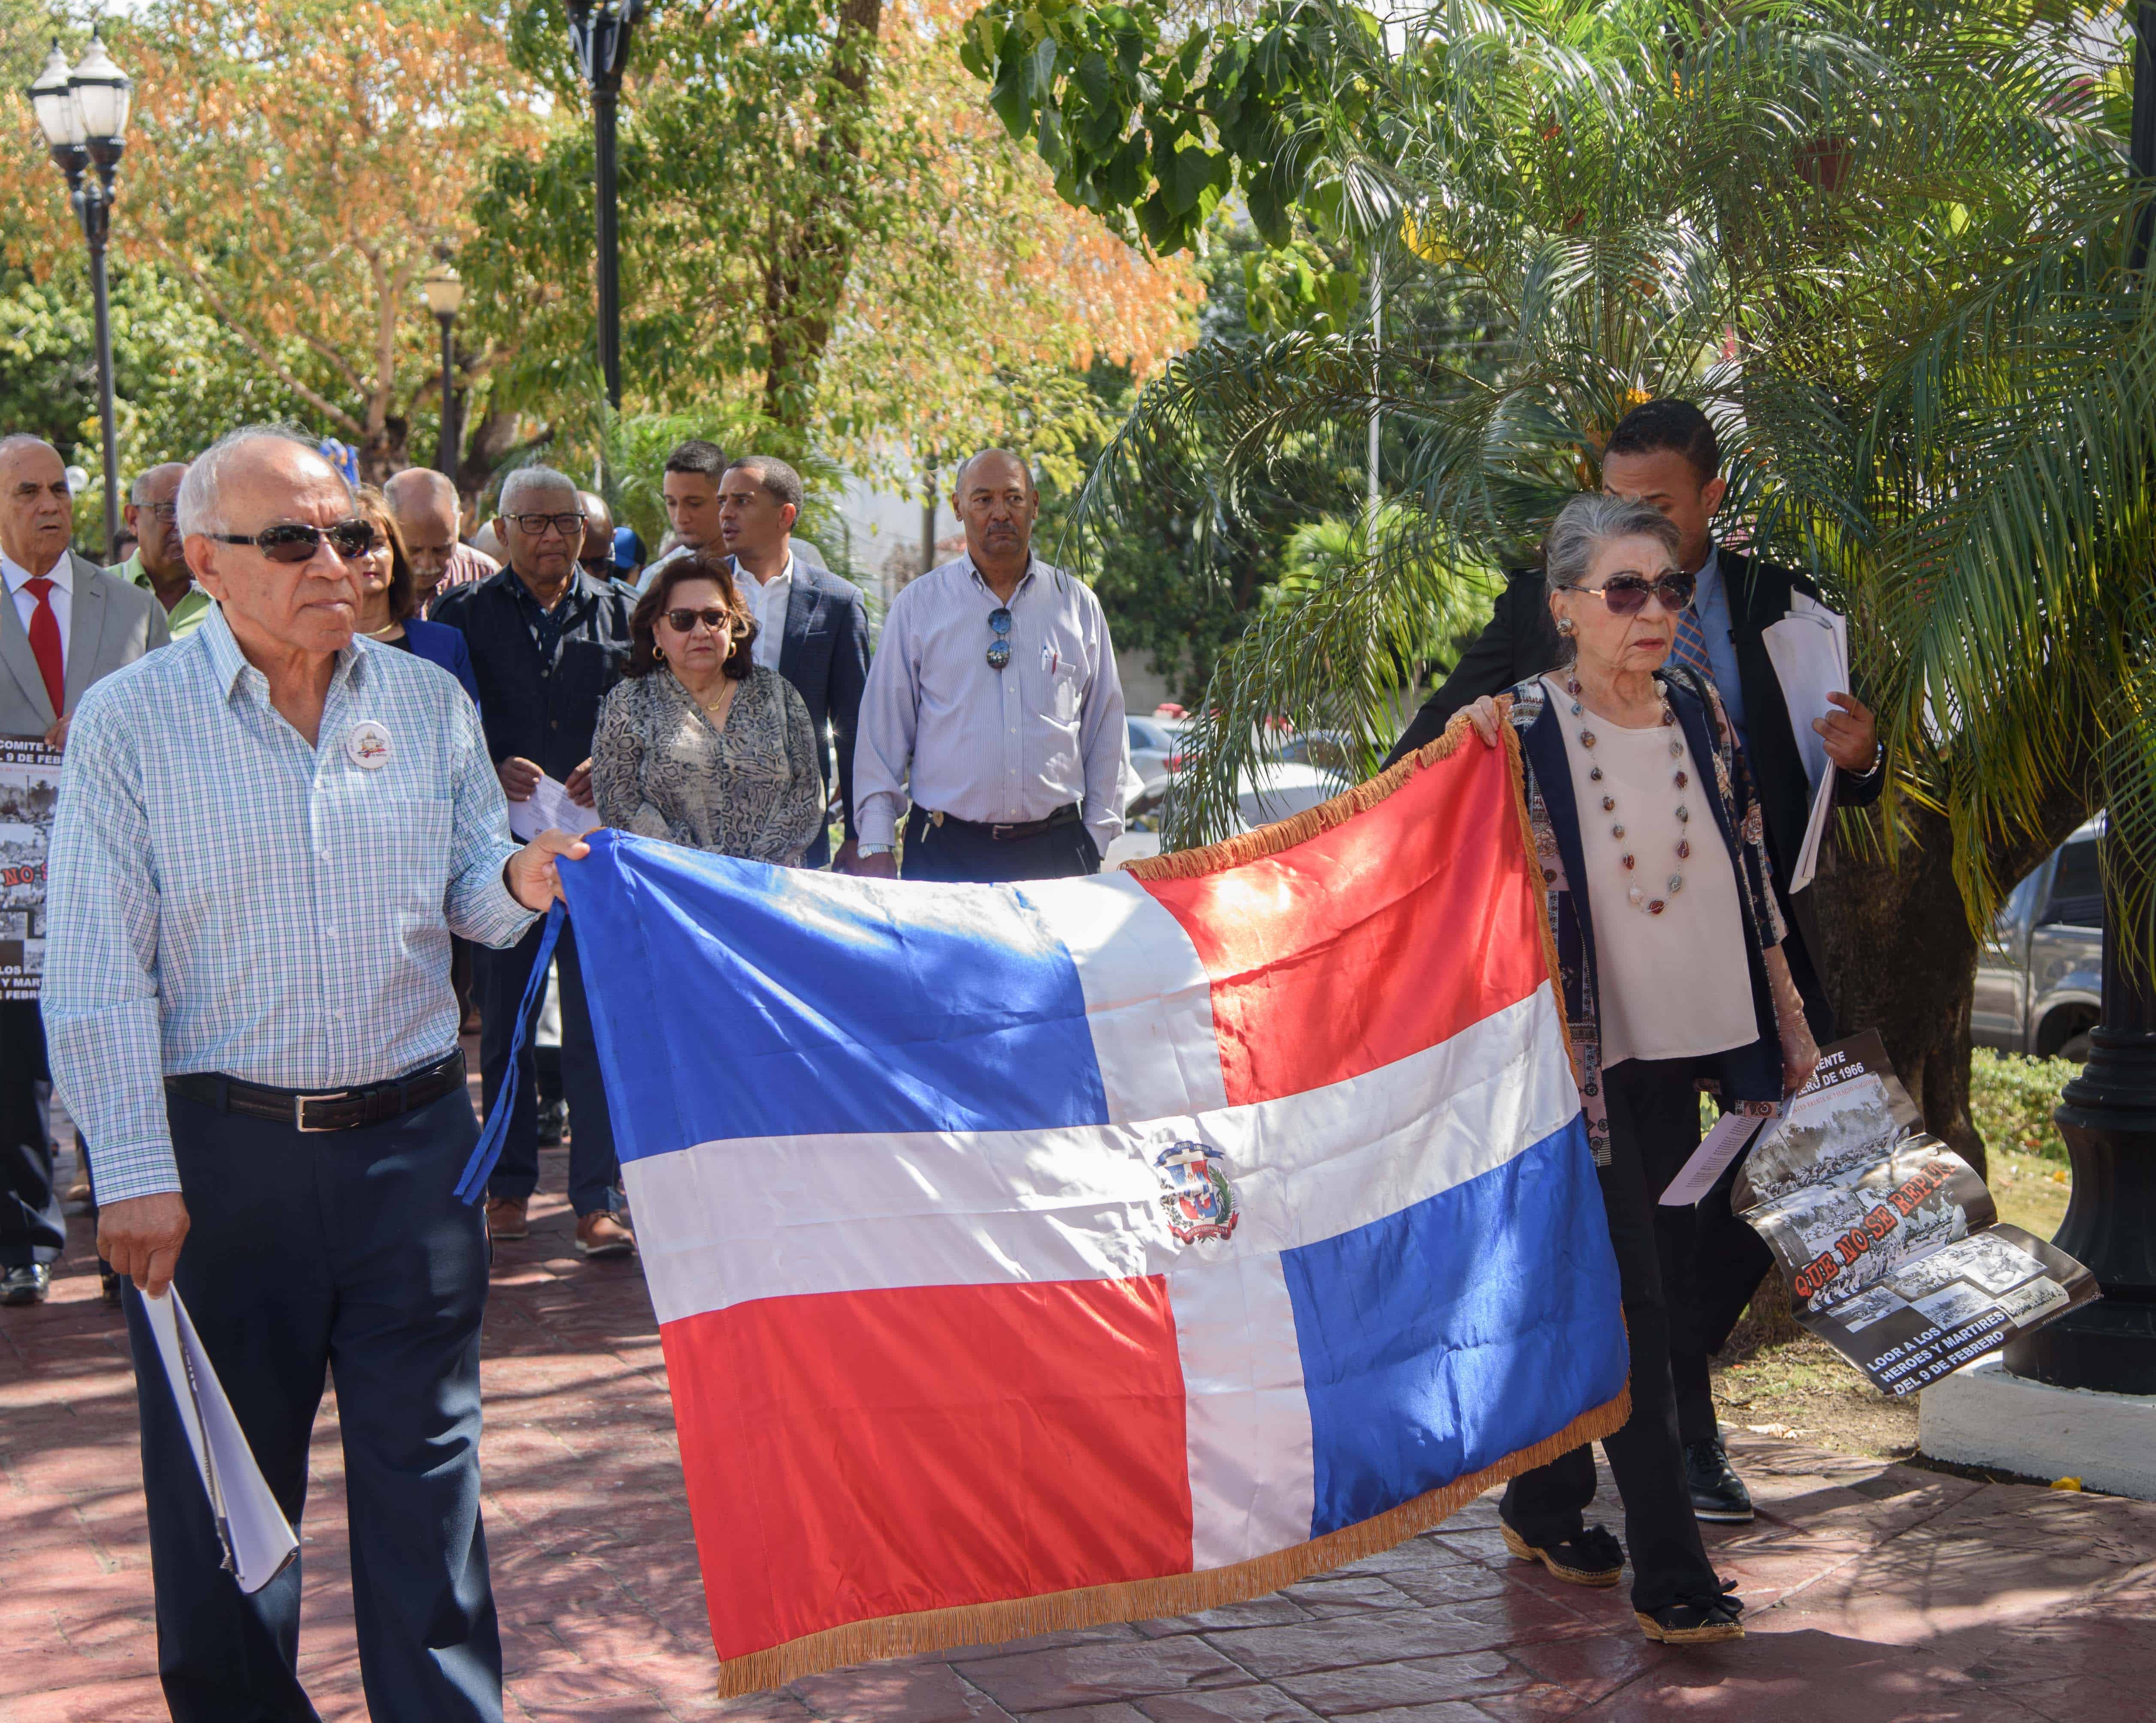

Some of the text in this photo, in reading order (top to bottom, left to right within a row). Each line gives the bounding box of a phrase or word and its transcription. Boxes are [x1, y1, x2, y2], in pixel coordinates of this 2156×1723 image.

[6, 753, 14, 762] 9
[18, 753, 34, 763] DE
[3, 866, 34, 886] NO
[2, 978, 10, 988] Y
[1822, 1071, 1838, 1086] DE
[1839, 1061, 1864, 1079] 1966
[1795, 1252, 1839, 1297] QUE
[1835, 1229, 1868, 1264] NO
[1865, 1205, 1897, 1239] SE
[1867, 1327, 1941, 1372] LOOR A LOS
[1880, 1311, 2005, 1383] HEROES Y MARTIRES
[1893, 1330, 2004, 1396] DEL 9 DE FEBRERO
